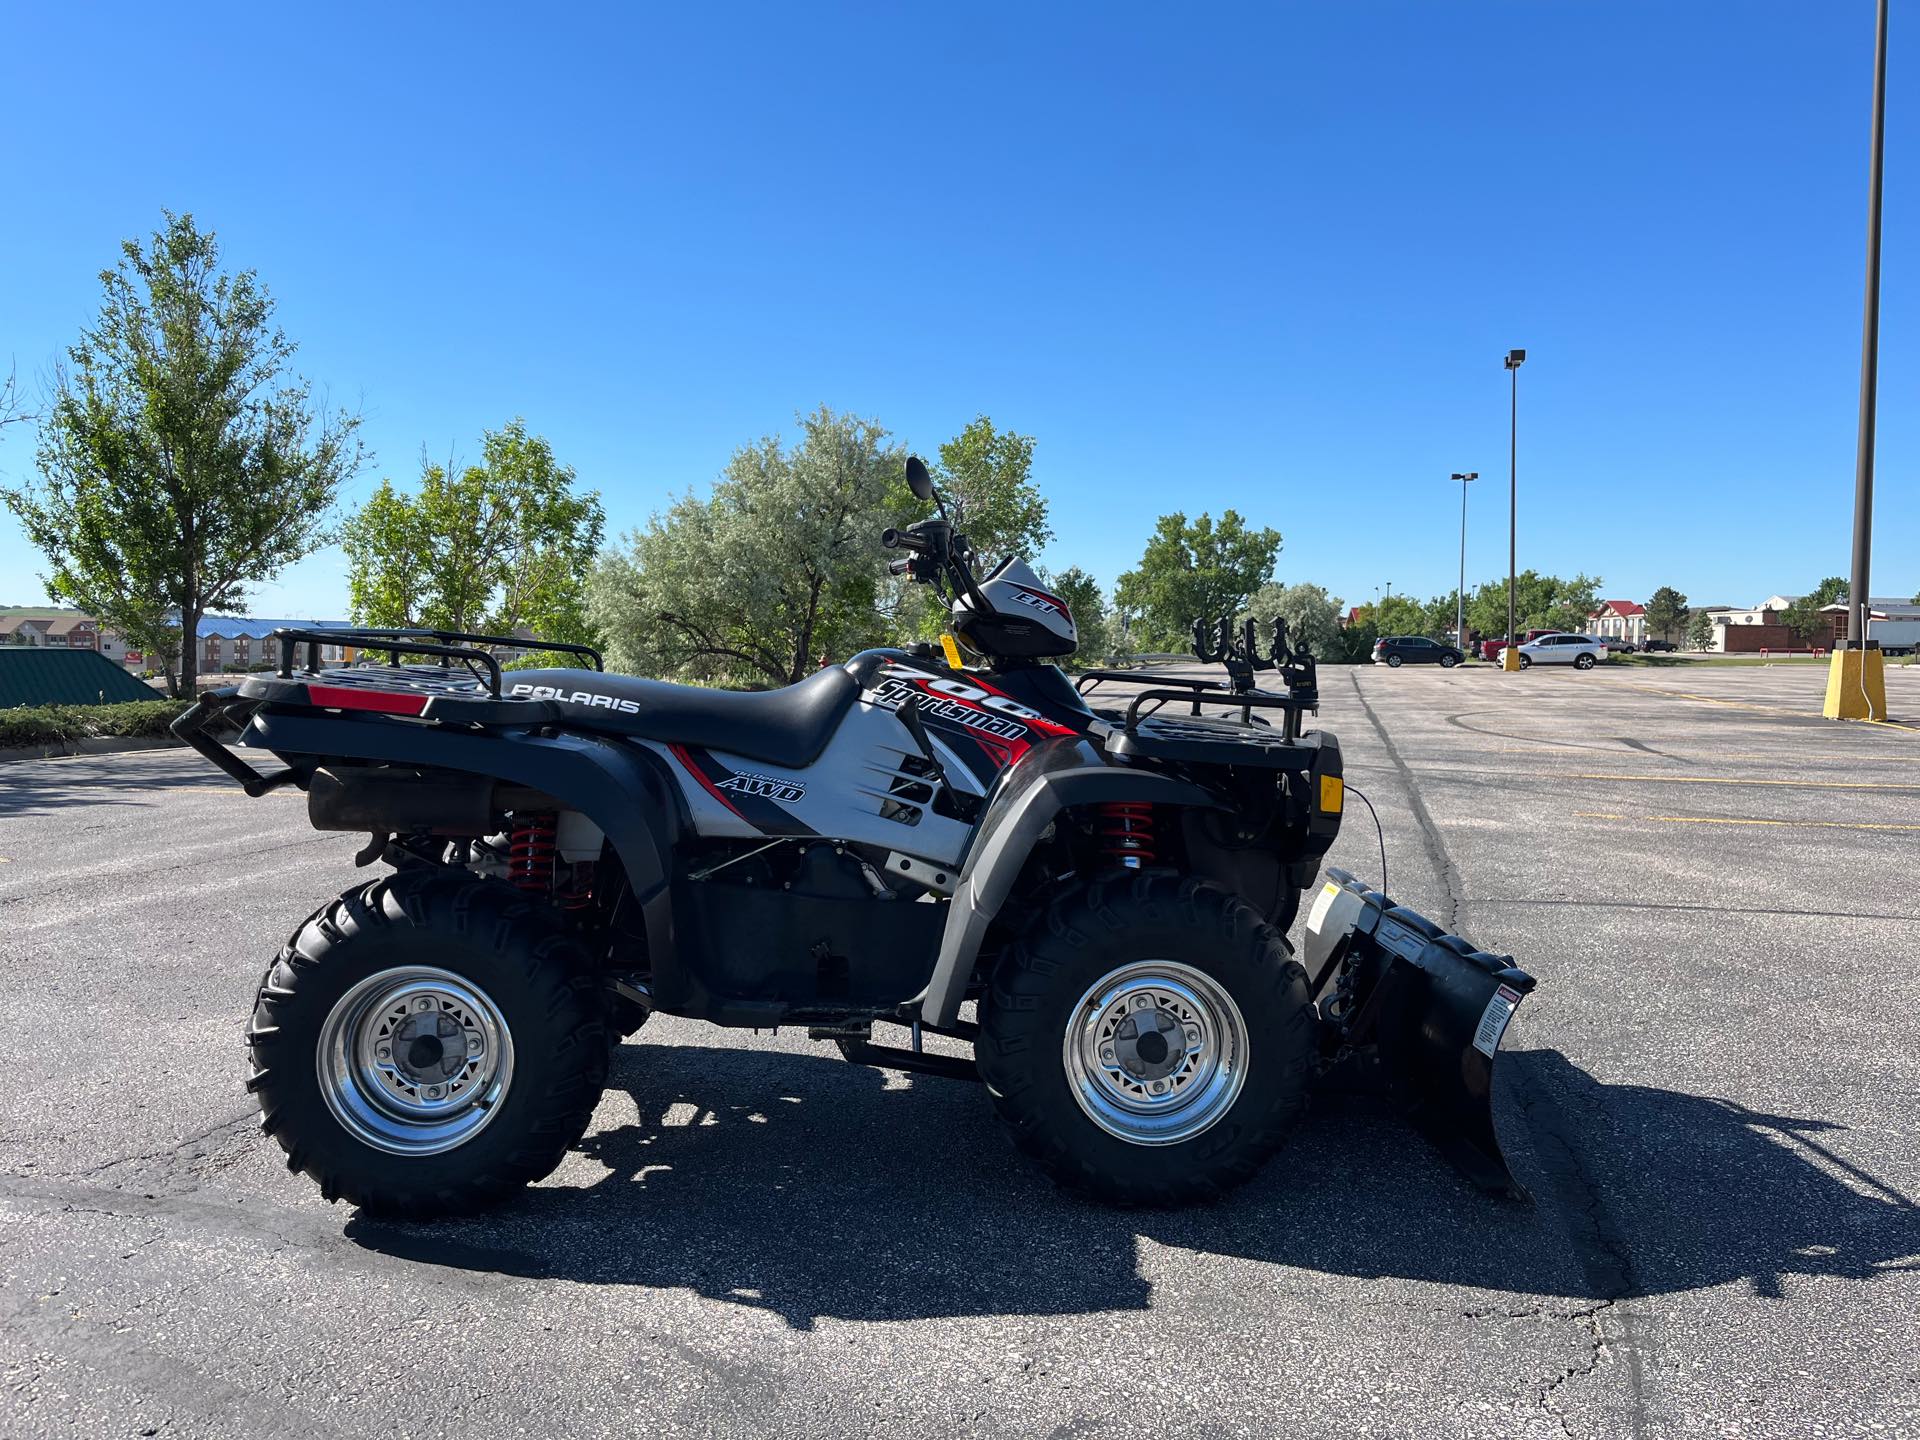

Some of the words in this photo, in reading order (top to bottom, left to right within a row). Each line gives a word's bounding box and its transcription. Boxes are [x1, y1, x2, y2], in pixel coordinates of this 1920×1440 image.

[1013, 592, 1057, 613] EFI
[511, 684, 641, 714] POLARIS
[879, 663, 1042, 719] 700
[714, 776, 806, 803] AWD
